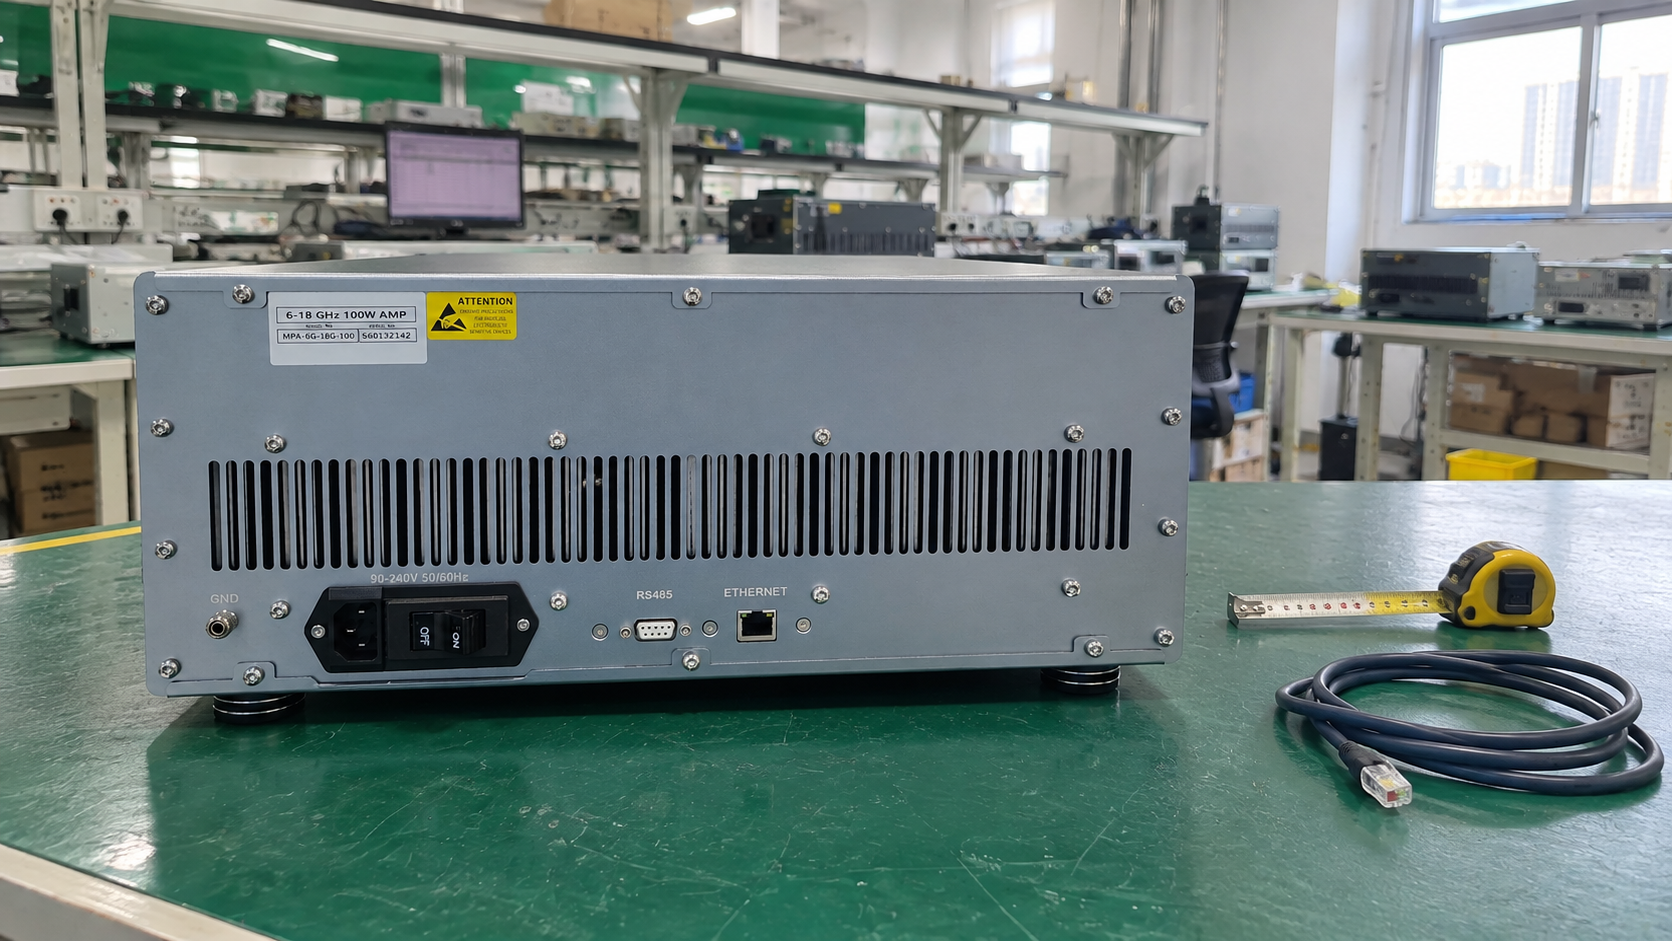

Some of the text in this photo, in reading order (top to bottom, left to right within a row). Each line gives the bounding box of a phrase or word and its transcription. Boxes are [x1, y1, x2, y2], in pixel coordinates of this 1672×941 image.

[458, 297, 513, 305] ATTENTION
[286, 310, 407, 319] 6-18 GHz 100W AMP
[370, 572, 469, 584] 90-240V 50/60Hz
[636, 590, 673, 600] RS485
[724, 586, 788, 598] ETHERNET
[210, 593, 239, 604] GND
[420, 626, 430, 646] OFF
[452, 632, 460, 649] ON
